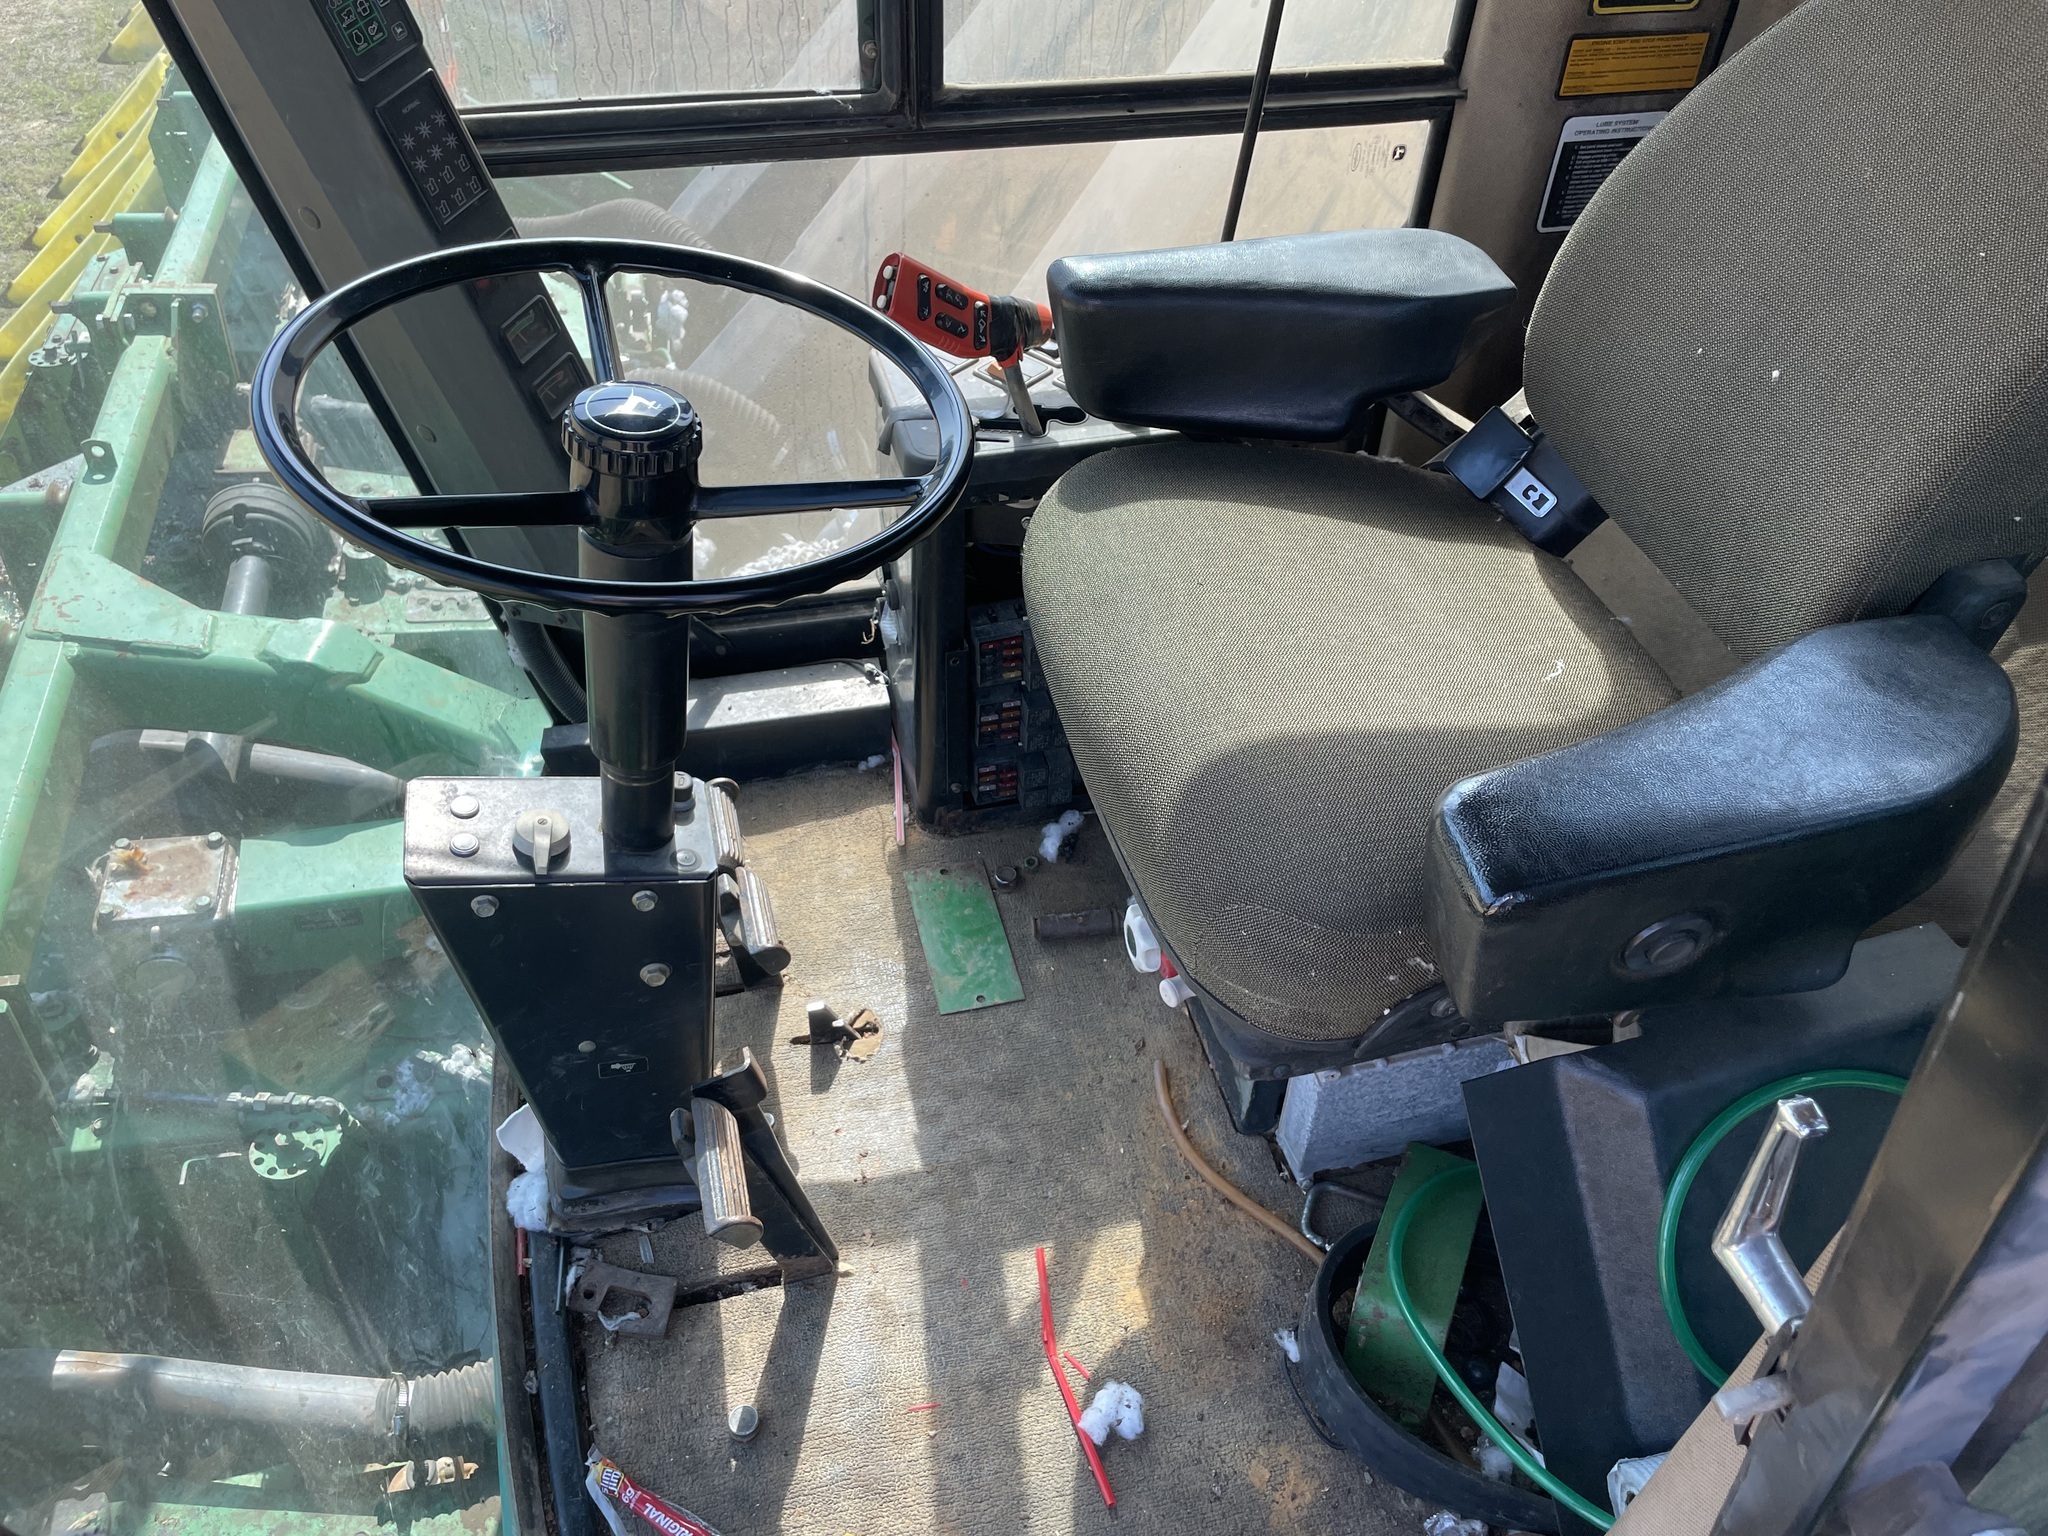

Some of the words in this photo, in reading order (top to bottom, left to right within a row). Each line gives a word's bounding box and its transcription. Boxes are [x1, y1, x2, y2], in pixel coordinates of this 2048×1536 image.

[1596, 120, 1614, 128] LUBE
[1614, 119, 1640, 127] SYSTEM
[1574, 128, 1610, 137] OPERATING
[1611, 126, 1655, 135] INSTRUCTION
